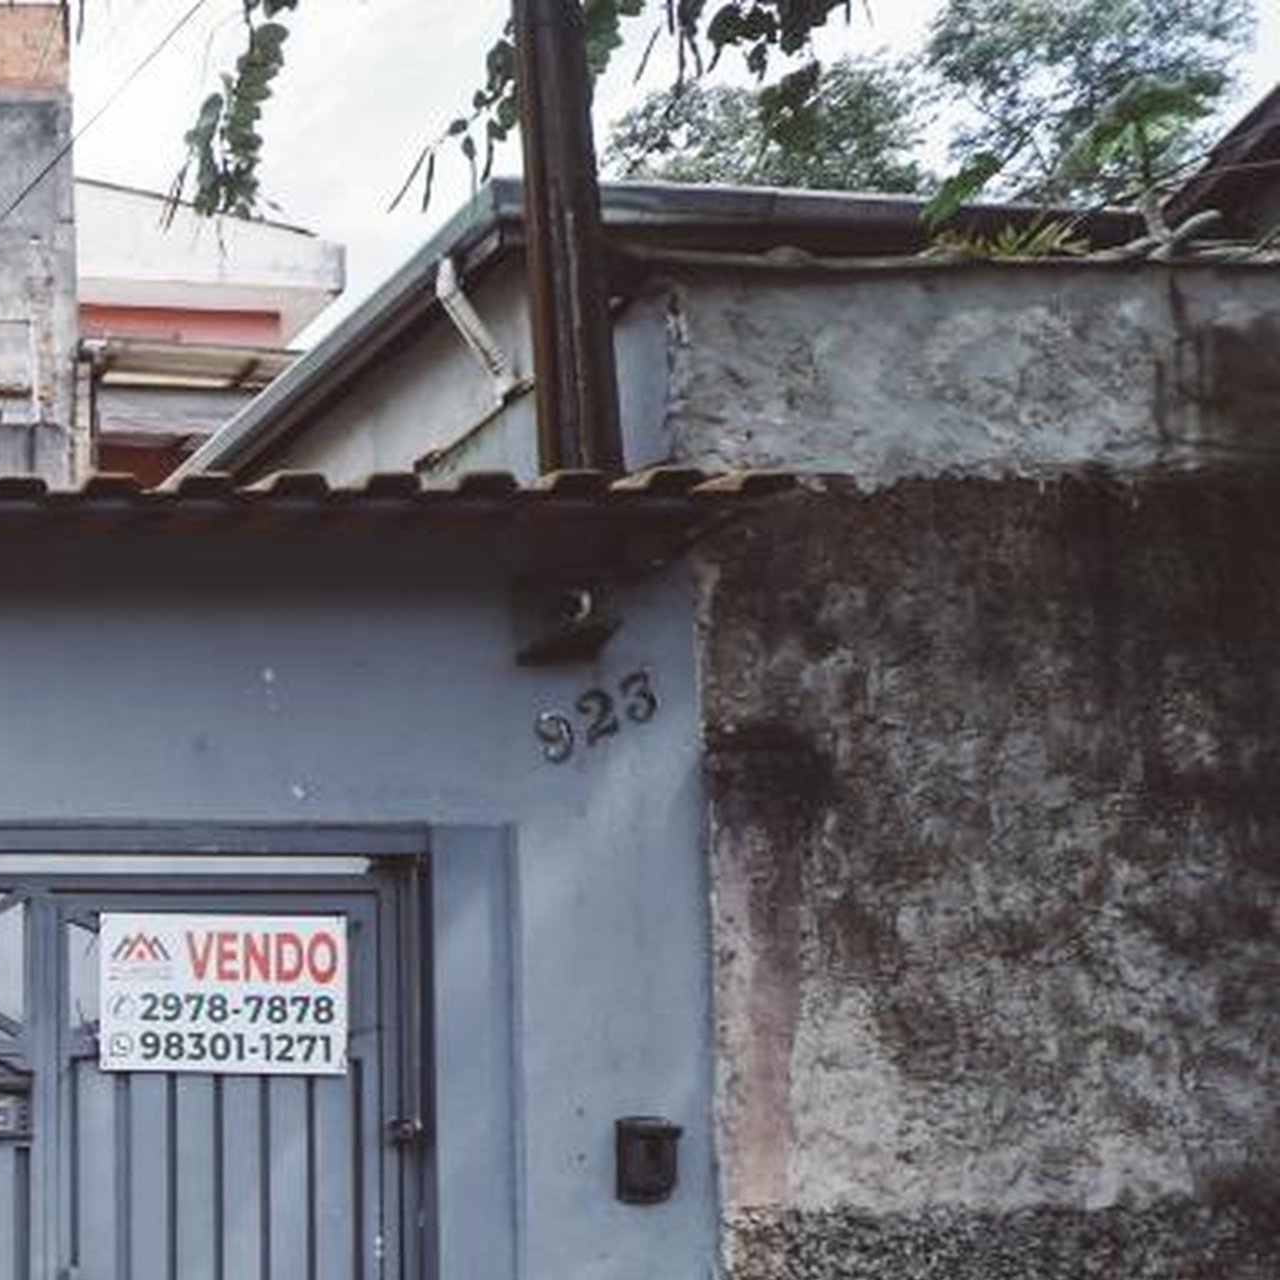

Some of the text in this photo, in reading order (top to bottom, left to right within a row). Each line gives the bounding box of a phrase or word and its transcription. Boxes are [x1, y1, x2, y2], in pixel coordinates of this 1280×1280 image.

[531, 668, 657, 764] 923
[186, 931, 338, 985] VENDO
[139, 992, 334, 1024] 2978-7878
[139, 1031, 332, 1063] 98301-1271
